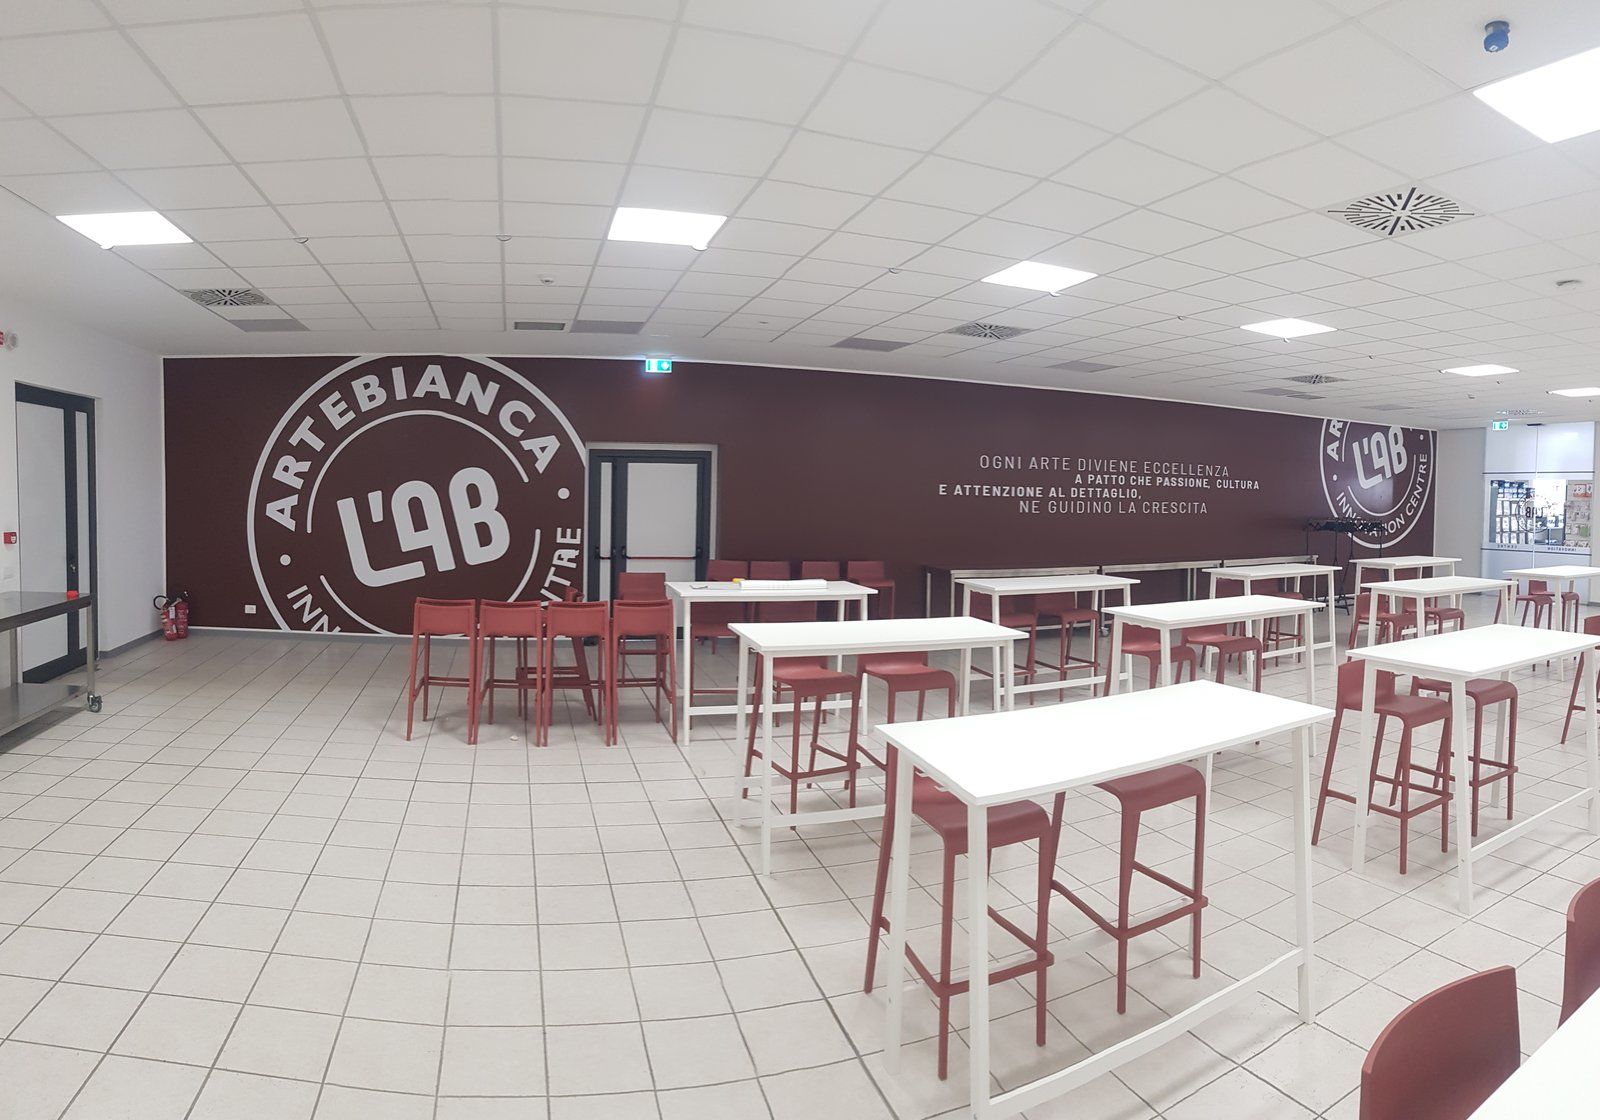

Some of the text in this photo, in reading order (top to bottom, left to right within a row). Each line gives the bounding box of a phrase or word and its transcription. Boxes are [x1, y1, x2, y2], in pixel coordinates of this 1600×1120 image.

[265, 364, 561, 532] ARTEBIANCA
[979, 454, 1230, 478] OGNI ARTE DIVIENE ECCELLENZA
[1352, 425, 1408, 490] L'AB
[938, 483, 1142, 500] E ATTENZIONE AL DETTAGLIO,
[1074, 473, 1260, 490] A PATTO CHE PASSIONE, CULTURA
[1405, 453, 1428, 516] CENTRE
[337, 467, 511, 588] L'AB
[1019, 500, 1208, 514] NE GUIDINO LA CRESCITA
[1336, 492, 1406, 538] INNAION
